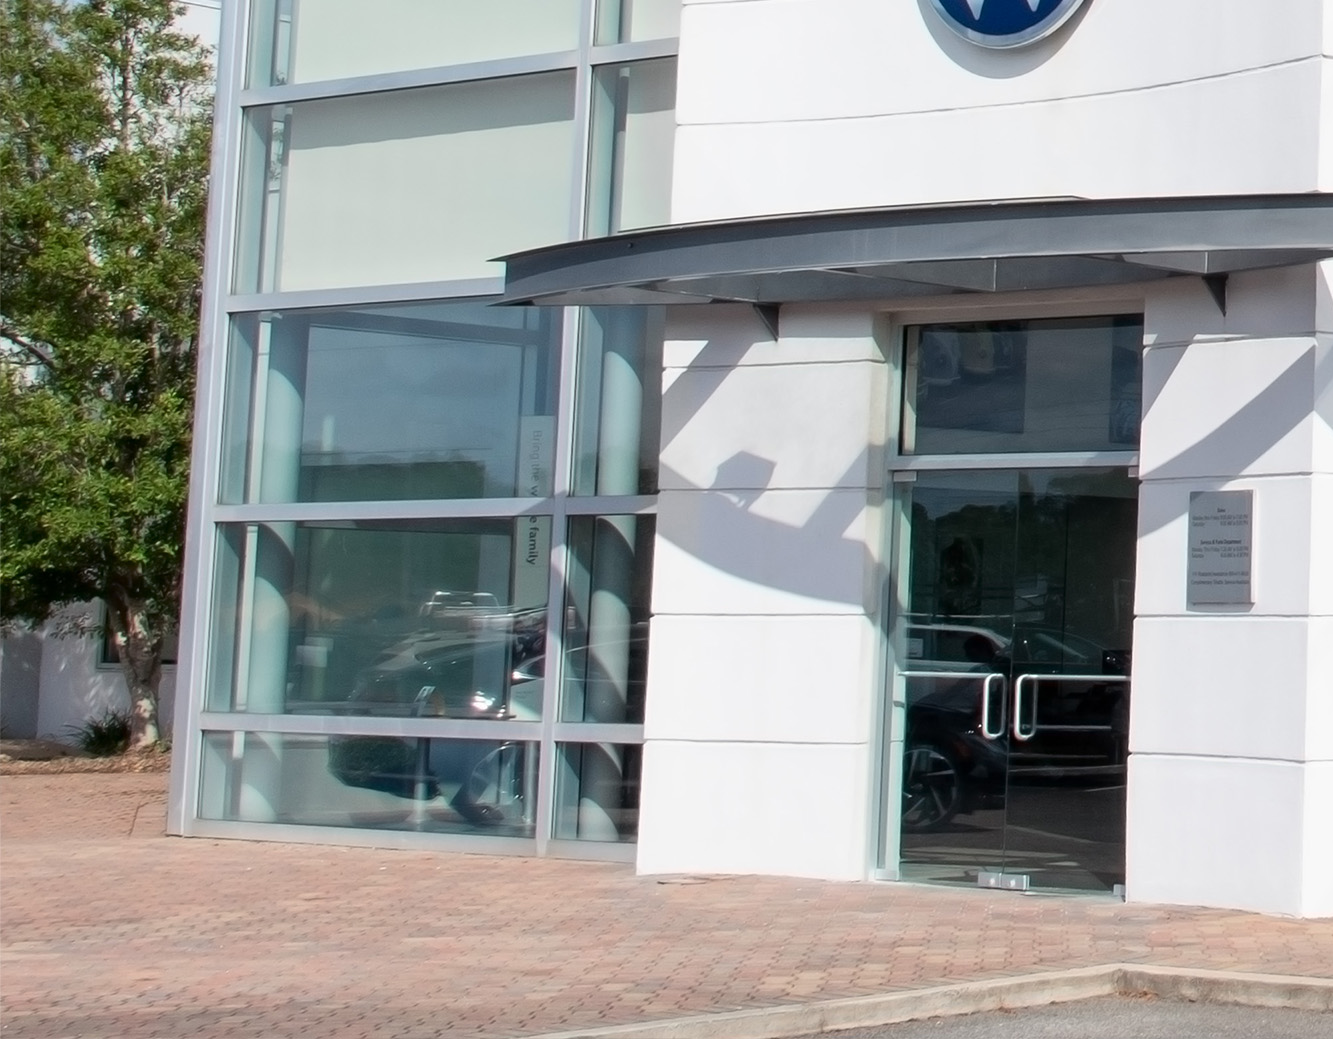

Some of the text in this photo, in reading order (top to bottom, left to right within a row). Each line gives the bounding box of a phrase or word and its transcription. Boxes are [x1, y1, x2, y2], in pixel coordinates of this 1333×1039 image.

[528, 430, 543, 459] Bring
[529, 462, 541, 481] the
[525, 527, 541, 566] family
